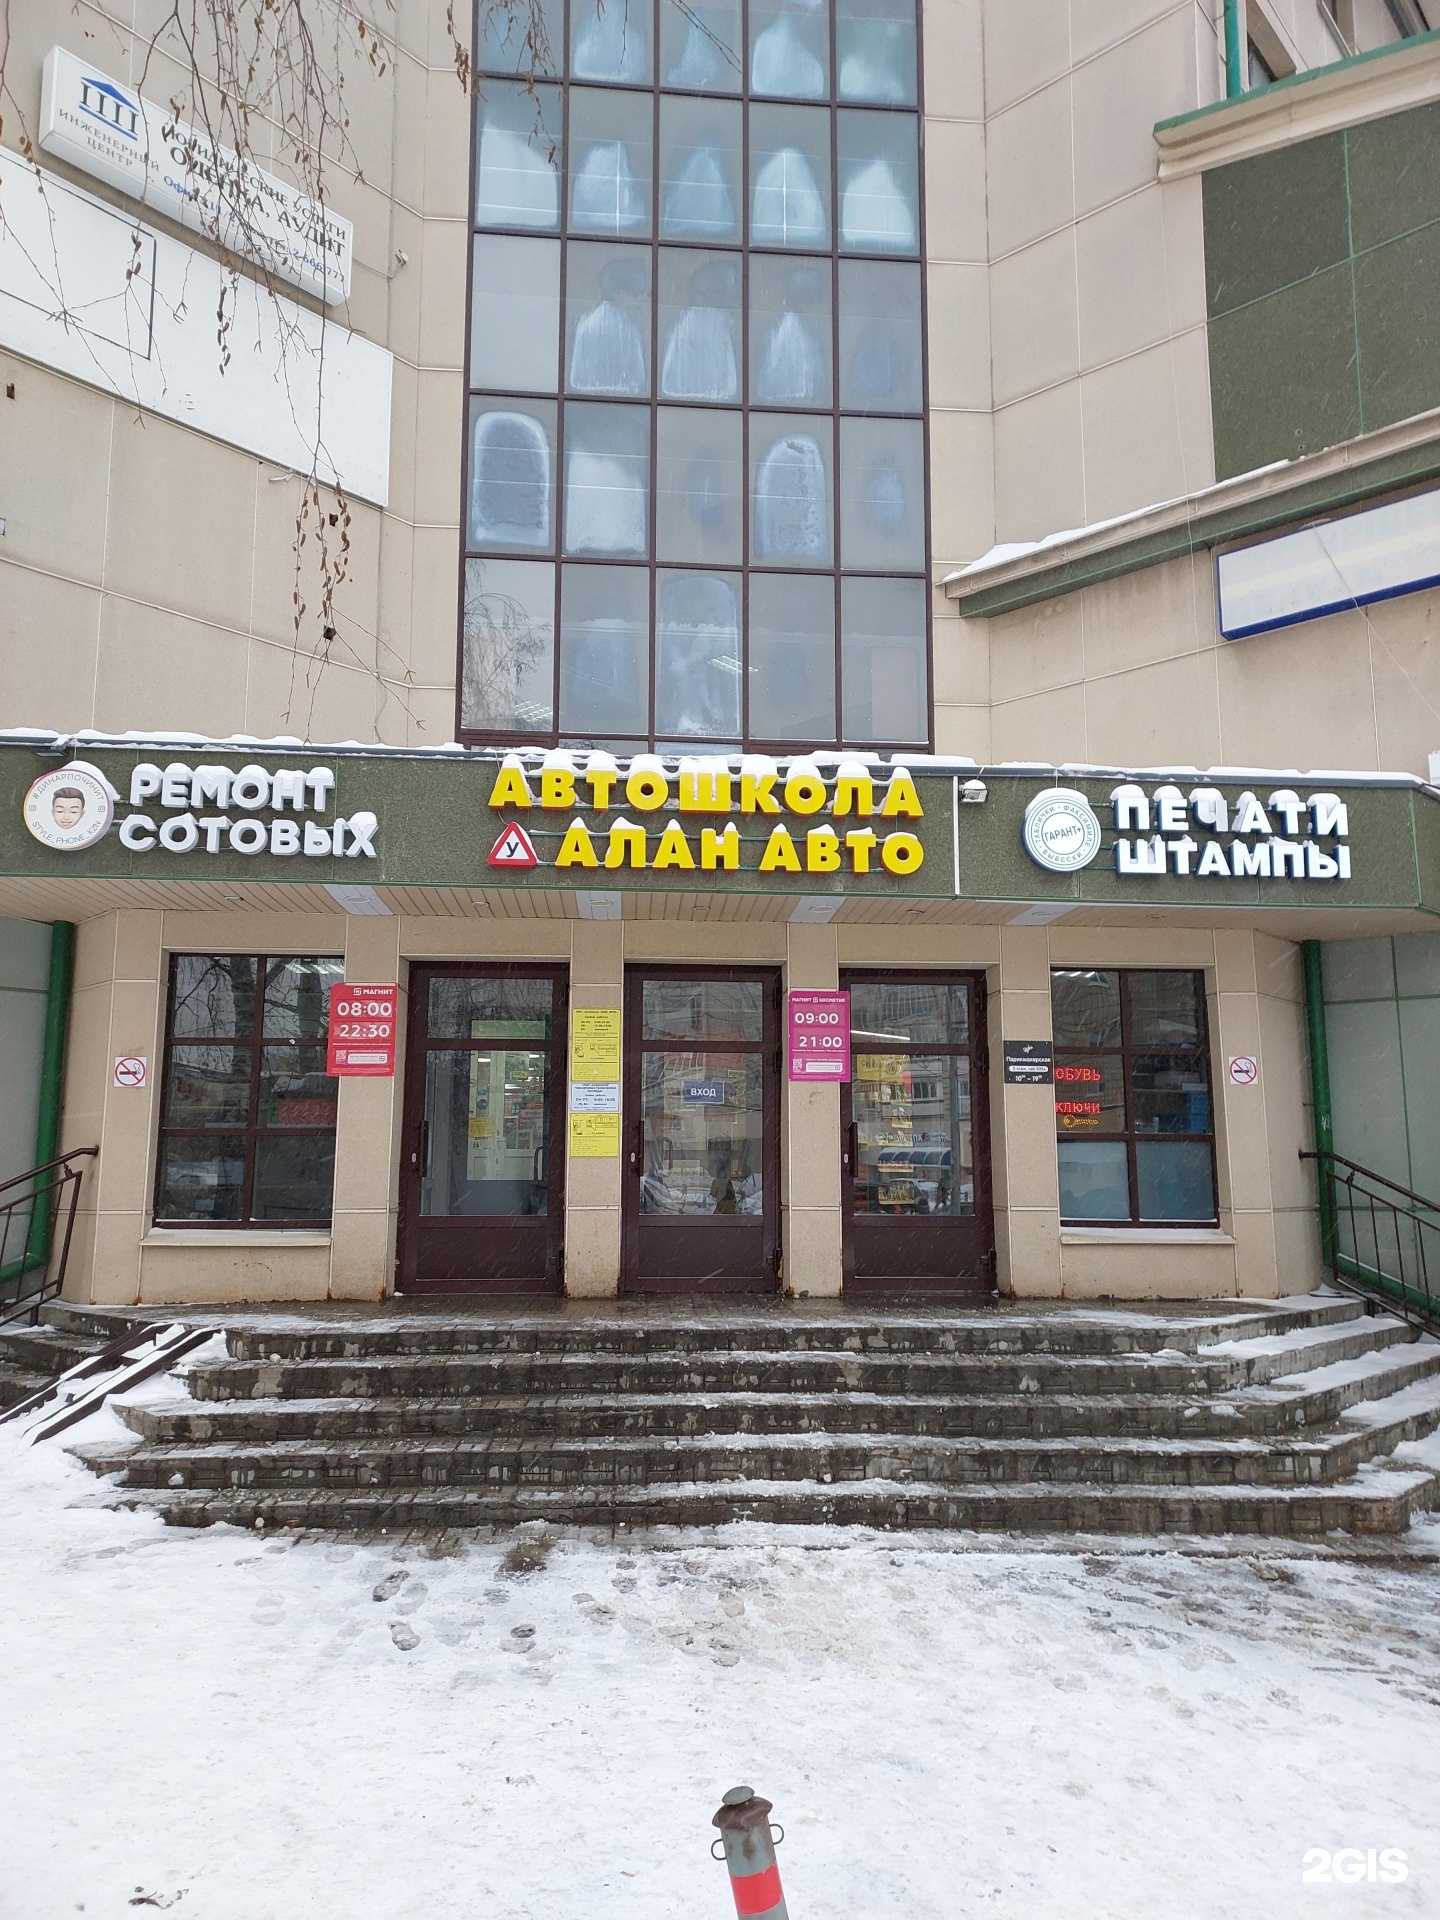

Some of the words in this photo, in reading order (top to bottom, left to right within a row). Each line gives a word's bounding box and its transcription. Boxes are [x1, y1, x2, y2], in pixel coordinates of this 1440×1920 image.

[88, 137, 133, 166] ЦЕНТР
[278, 210, 345, 256] АУДИТ
[130, 768, 335, 812] РЕМОНТ
[488, 765, 924, 818] АВТОШКОЛА
[1115, 796, 1349, 836] ПЕЧАТИ
[119, 816, 377, 858] СОТОВЫХ
[555, 822, 740, 870] АЛАН
[759, 825, 925, 875] АВТО
[1115, 838, 1352, 879] ШТАМПЫ
[337, 1002, 392, 1016] 08:00
[794, 1012, 839, 1024] 09:00
[340, 1024, 390, 1038] 22:30
[799, 1036, 842, 1048] 21:00
[1055, 1067, 1101, 1081] ОБУВЬ
[690, 1087, 717, 1098] ВХОД
[1055, 1102, 1101, 1113] КЛЮЧИ
